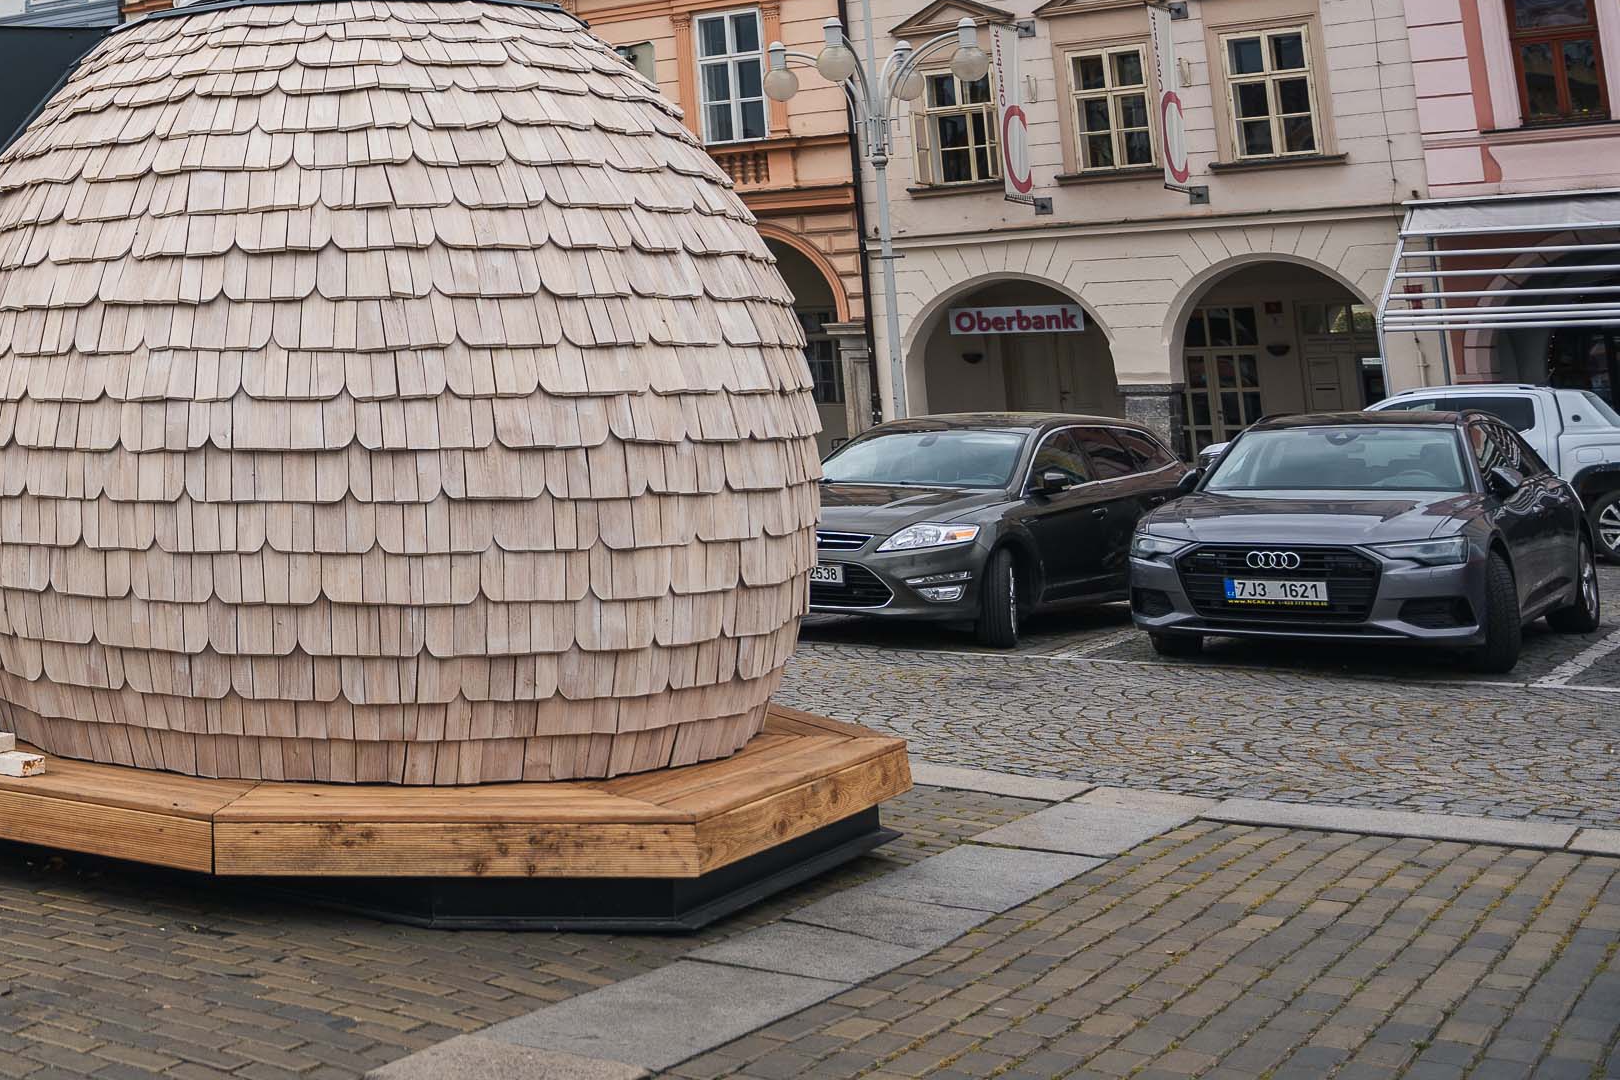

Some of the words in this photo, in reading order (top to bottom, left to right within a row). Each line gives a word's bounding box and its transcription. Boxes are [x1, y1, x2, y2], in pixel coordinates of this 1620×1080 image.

[993, 28, 1006, 107] Oberbank
[955, 307, 1078, 333] Oberbank
[810, 566, 838, 581] 2538
[1236, 581, 1267, 597] 7J3
[1280, 583, 1319, 599] 1621
